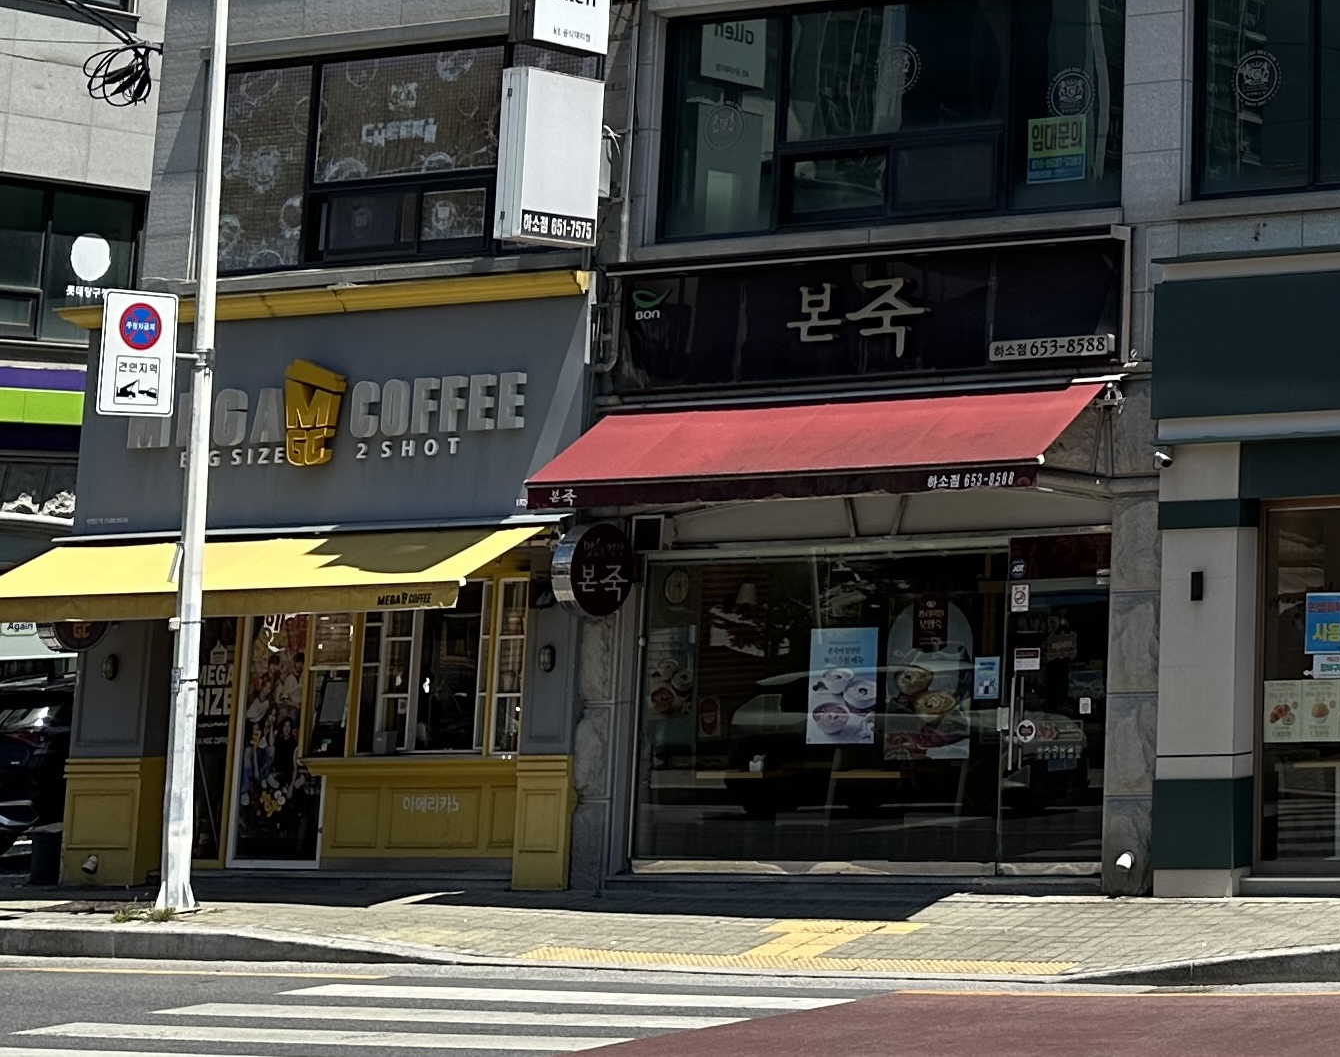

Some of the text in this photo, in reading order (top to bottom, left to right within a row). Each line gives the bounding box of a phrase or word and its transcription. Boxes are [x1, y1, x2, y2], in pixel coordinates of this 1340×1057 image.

[1031, 122, 1082, 151] 임대문의
[524, 212, 592, 241] 하소점 651-7575
[635, 309, 660, 320] BON
[787, 277, 931, 358] 본죽
[126, 321, 156, 331] 주정차금지
[993, 336, 1105, 359] 하소점 653-8588
[118, 362, 158, 374] 견인지역
[350, 372, 527, 438] COFFEE
[180, 448, 285, 468] BG SIZE
[356, 437, 461, 459] 2 SHOT
[927, 471, 1015, 488] 하소점 653-8588
[549, 489, 577, 507] 본죽
[578, 564, 629, 603] 본죽
[377, 592, 433, 606] MEGA COFFEE
